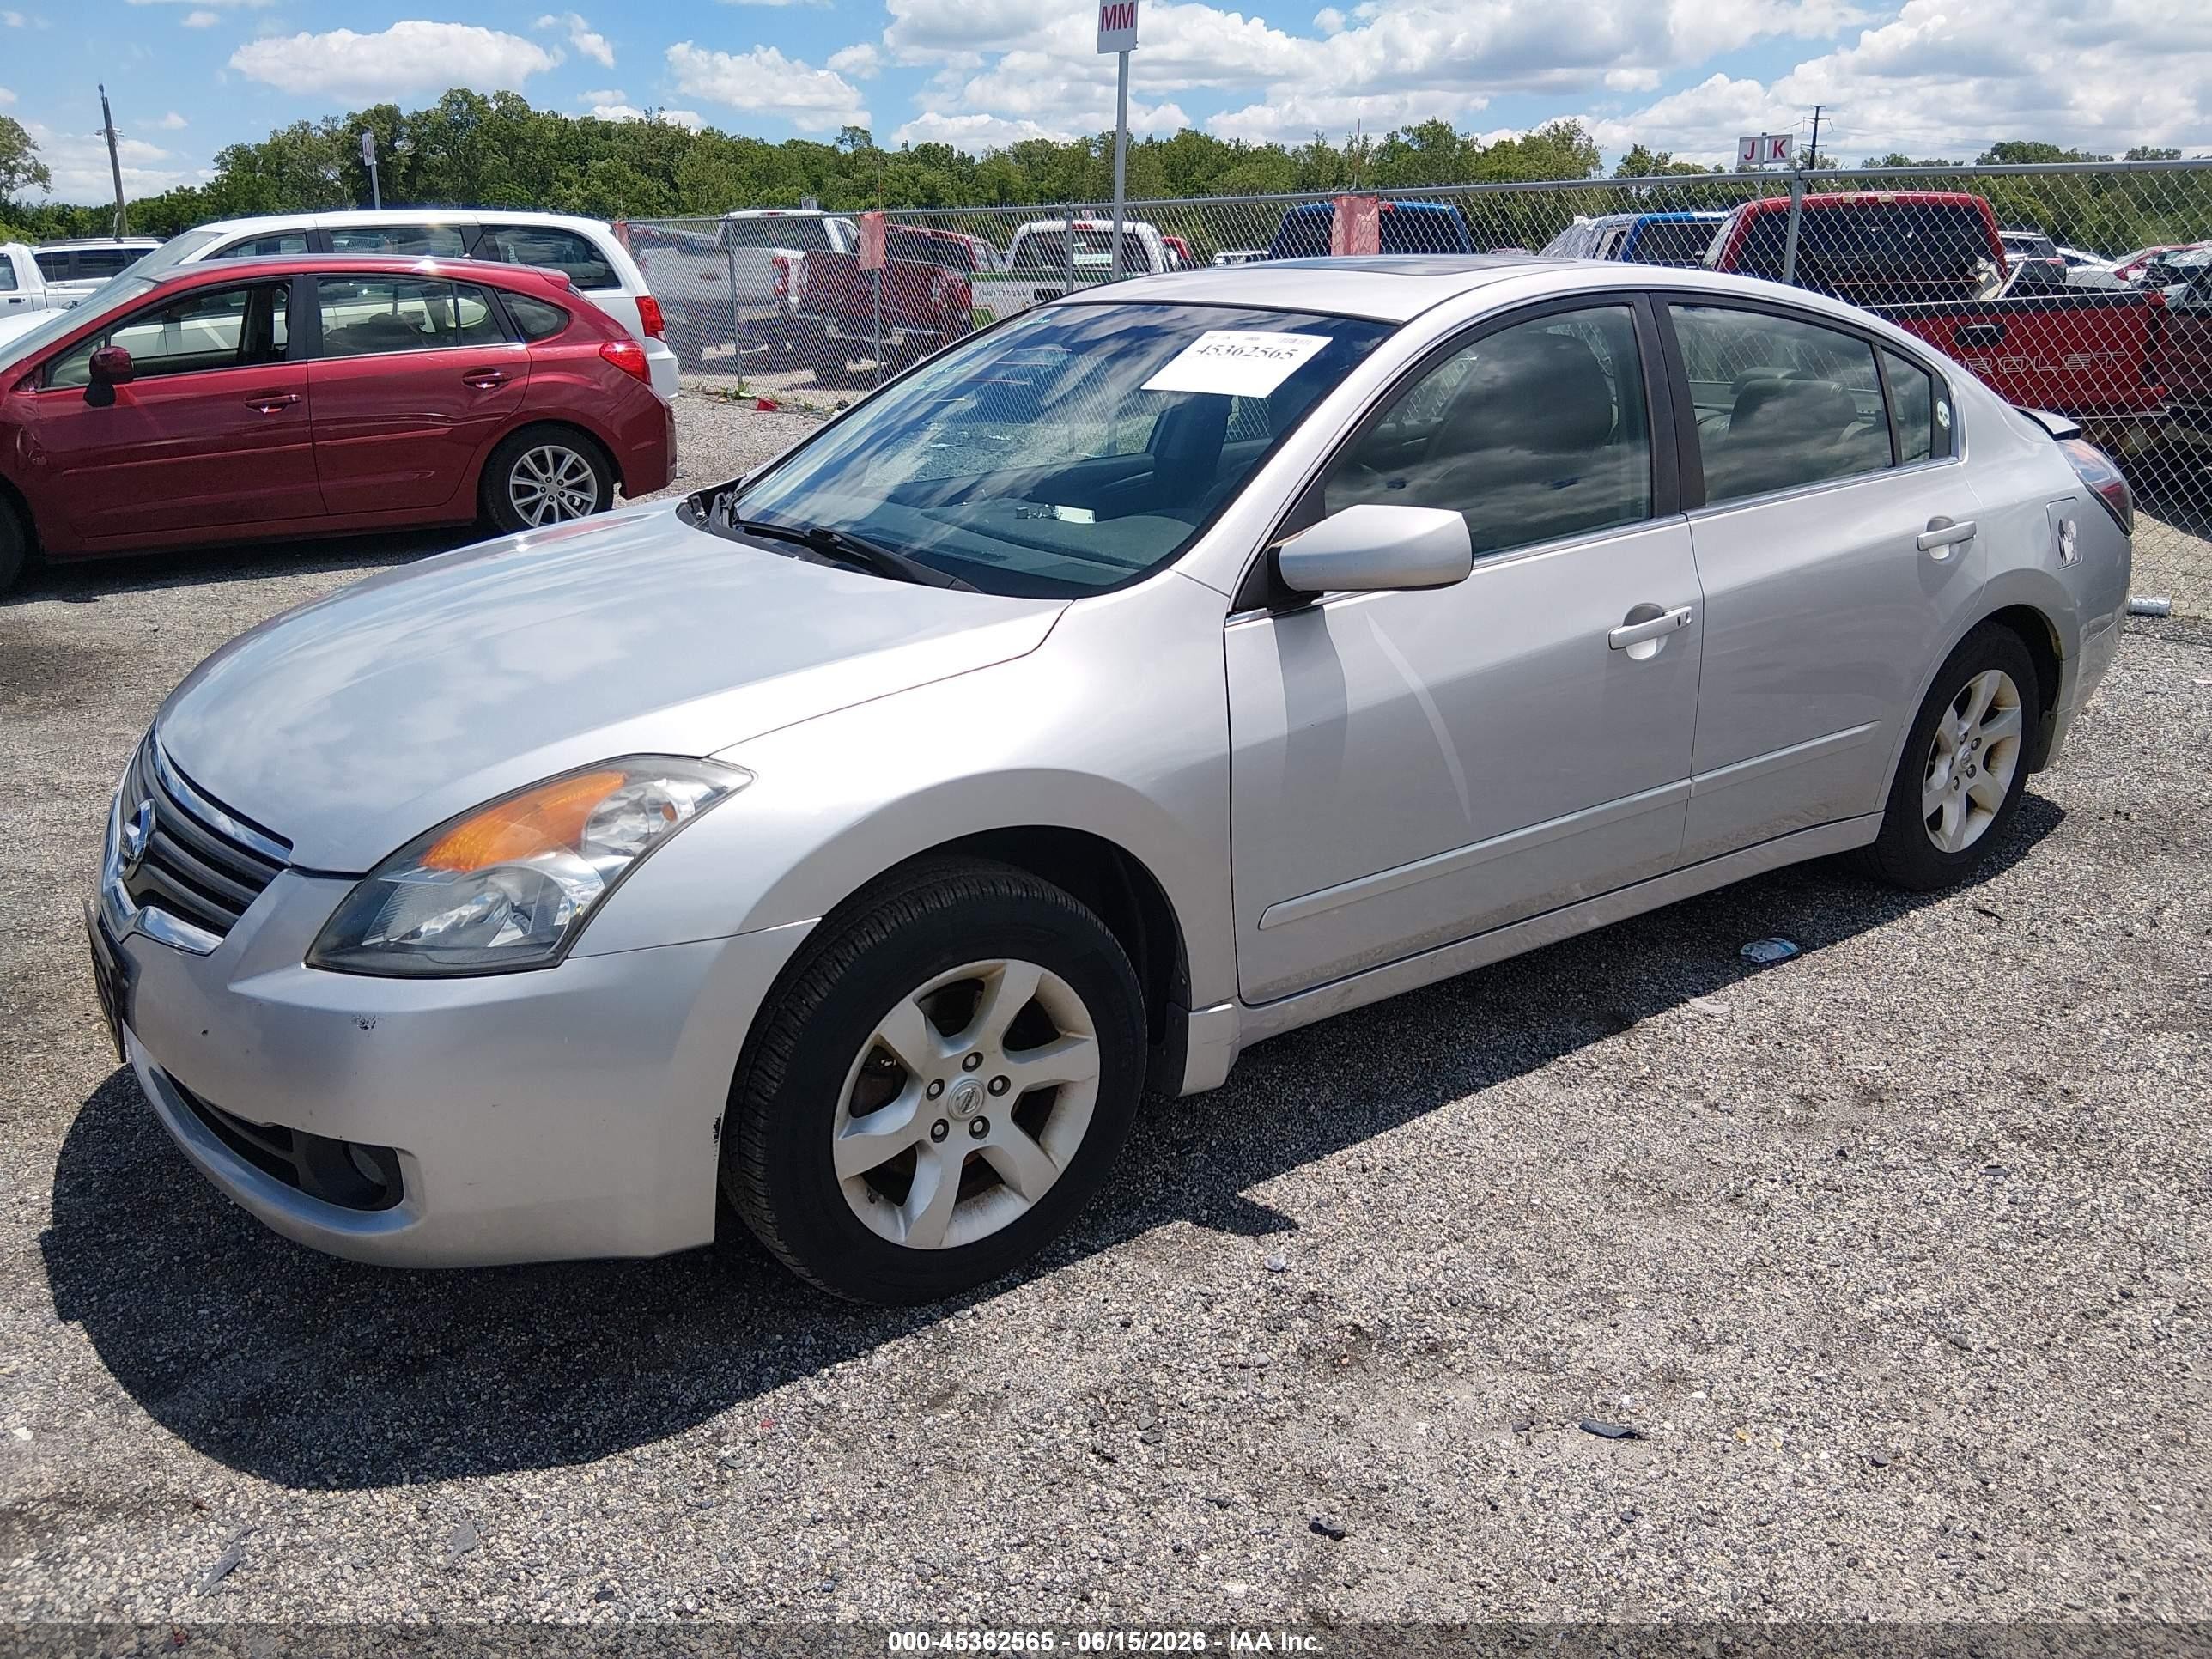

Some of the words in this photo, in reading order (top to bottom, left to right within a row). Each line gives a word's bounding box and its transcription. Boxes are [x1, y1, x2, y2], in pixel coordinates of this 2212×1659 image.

[1101, 2, 1134, 32] MM
[1744, 141, 1756, 161] J
[1772, 139, 1787, 159] K
[1196, 344, 1299, 360] 45362565
